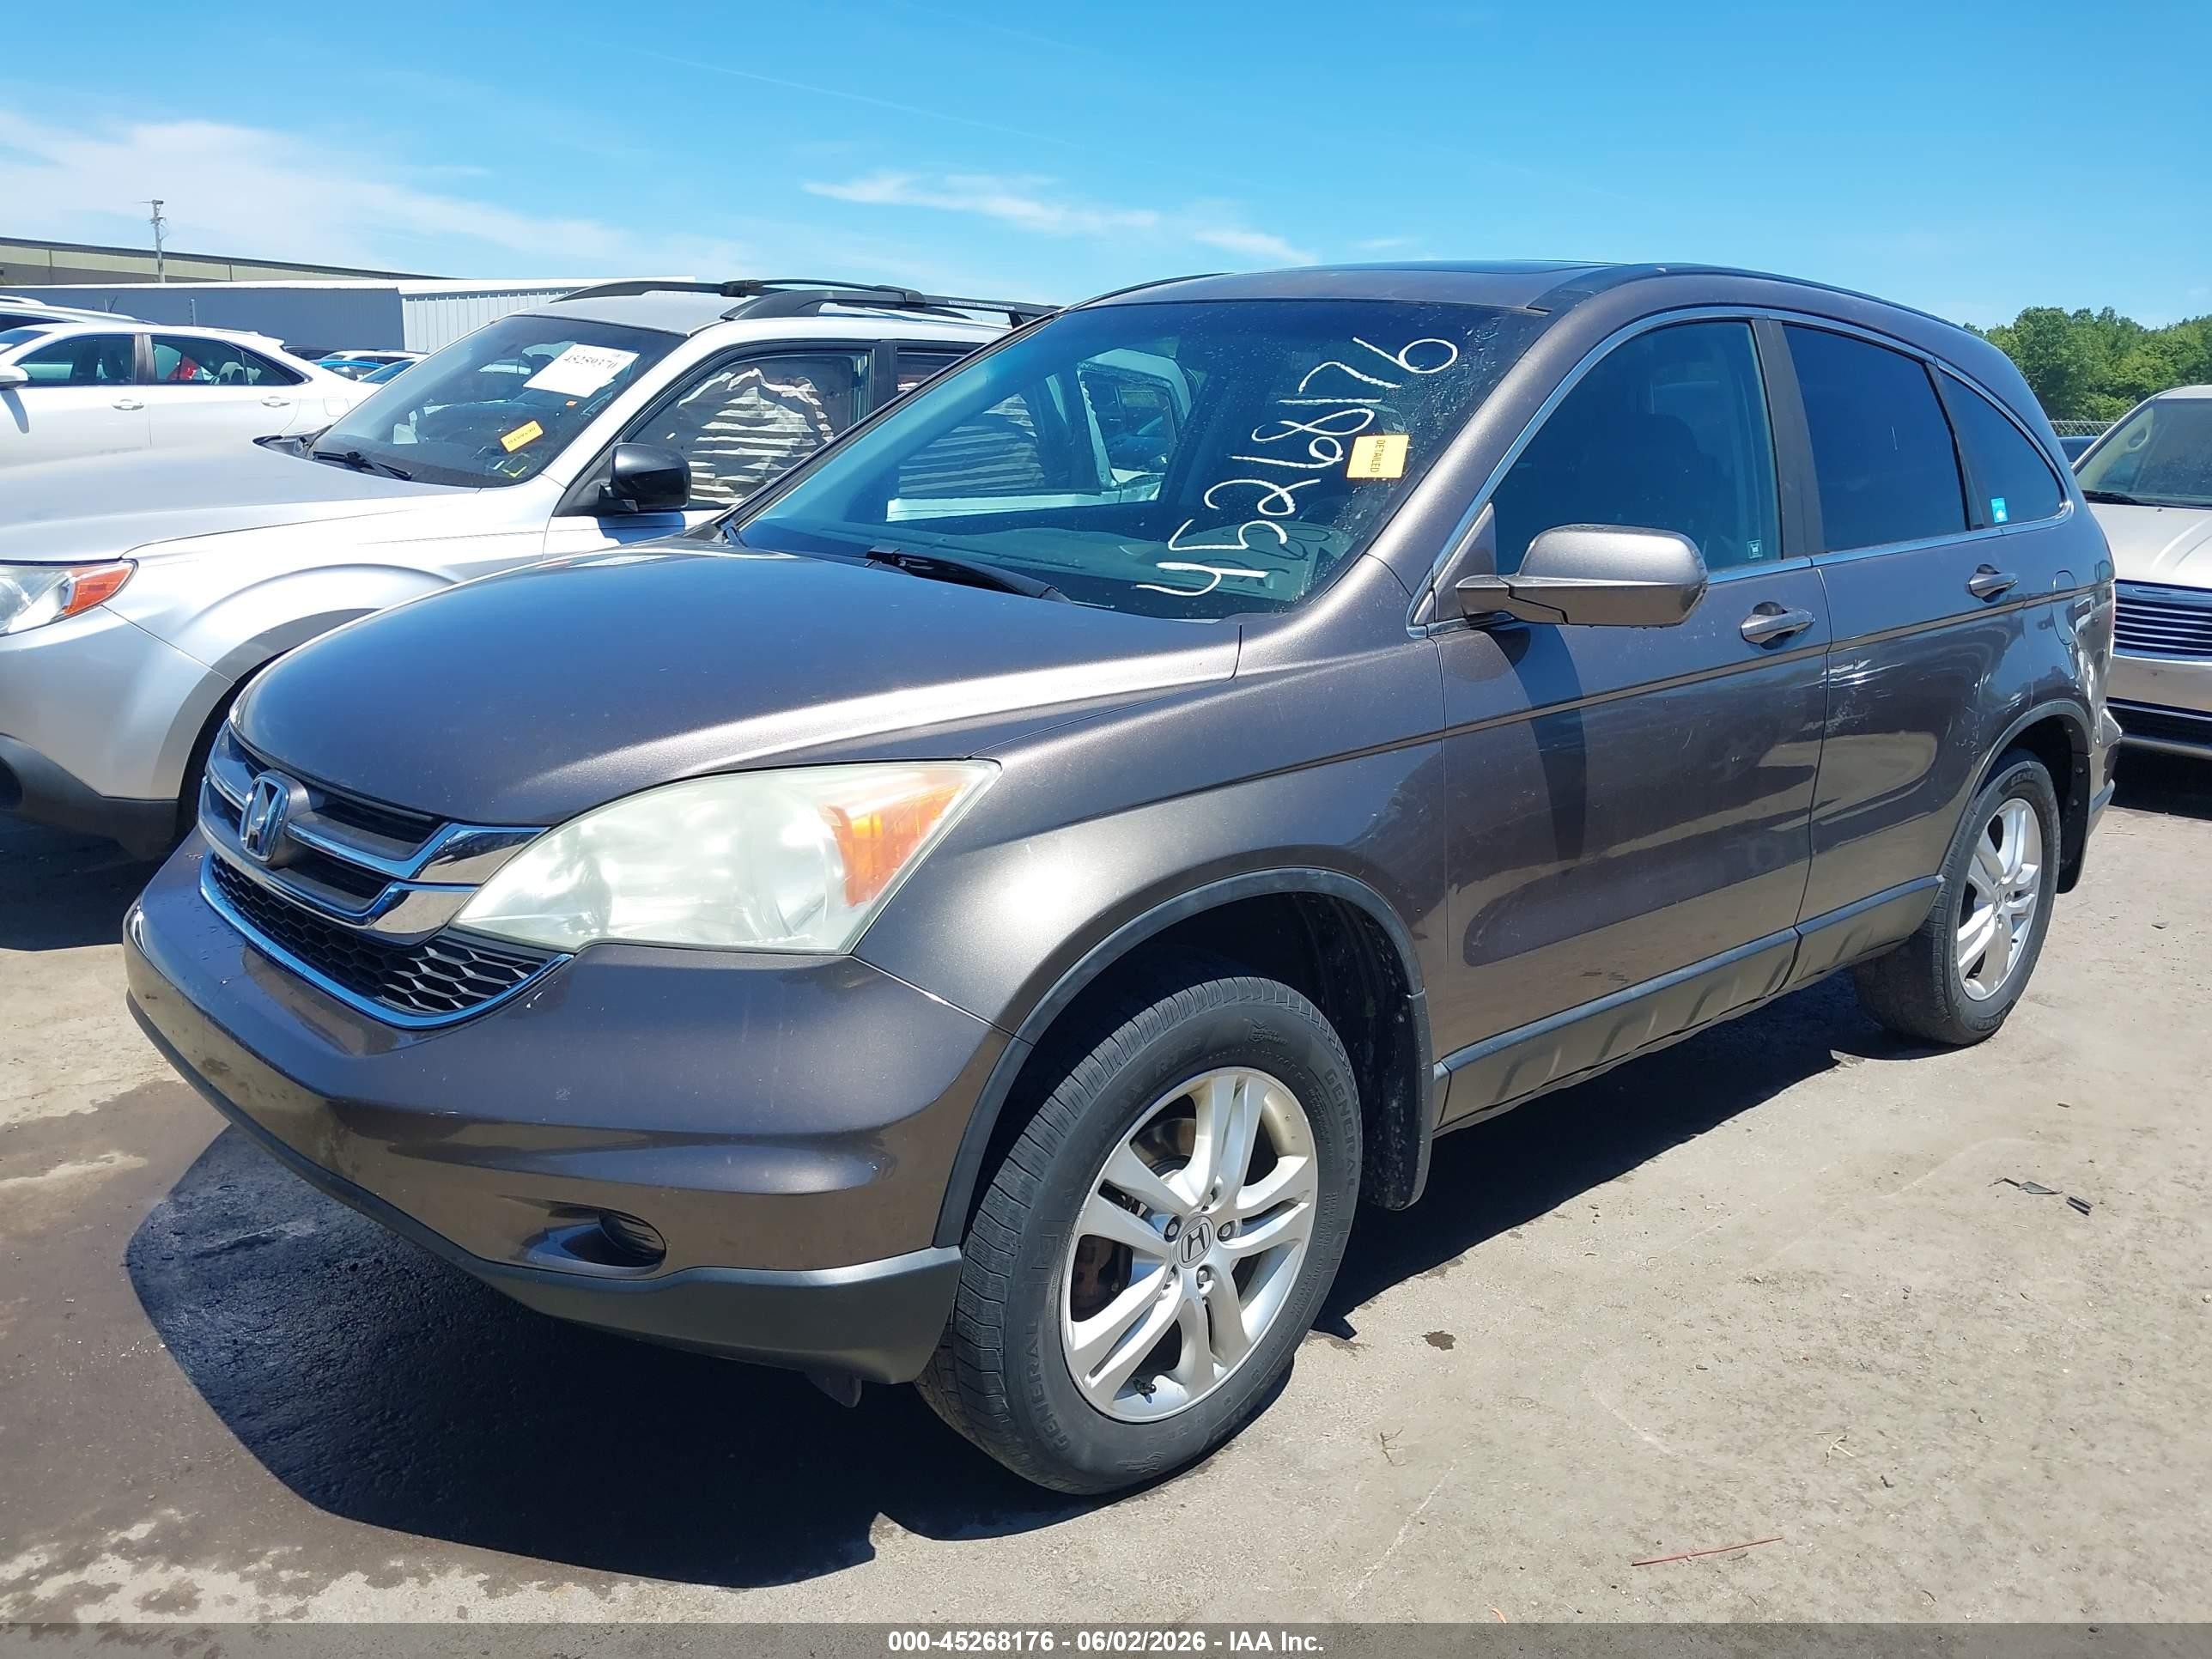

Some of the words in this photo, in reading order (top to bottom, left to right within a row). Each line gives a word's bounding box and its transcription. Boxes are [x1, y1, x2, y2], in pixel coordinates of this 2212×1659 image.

[1135, 337, 1459, 596] 45268176
[1369, 439, 1387, 473] DETAILED
[1324, 1068, 1357, 1195] GENERAL
[1025, 1319, 1071, 1452] GENERAL
